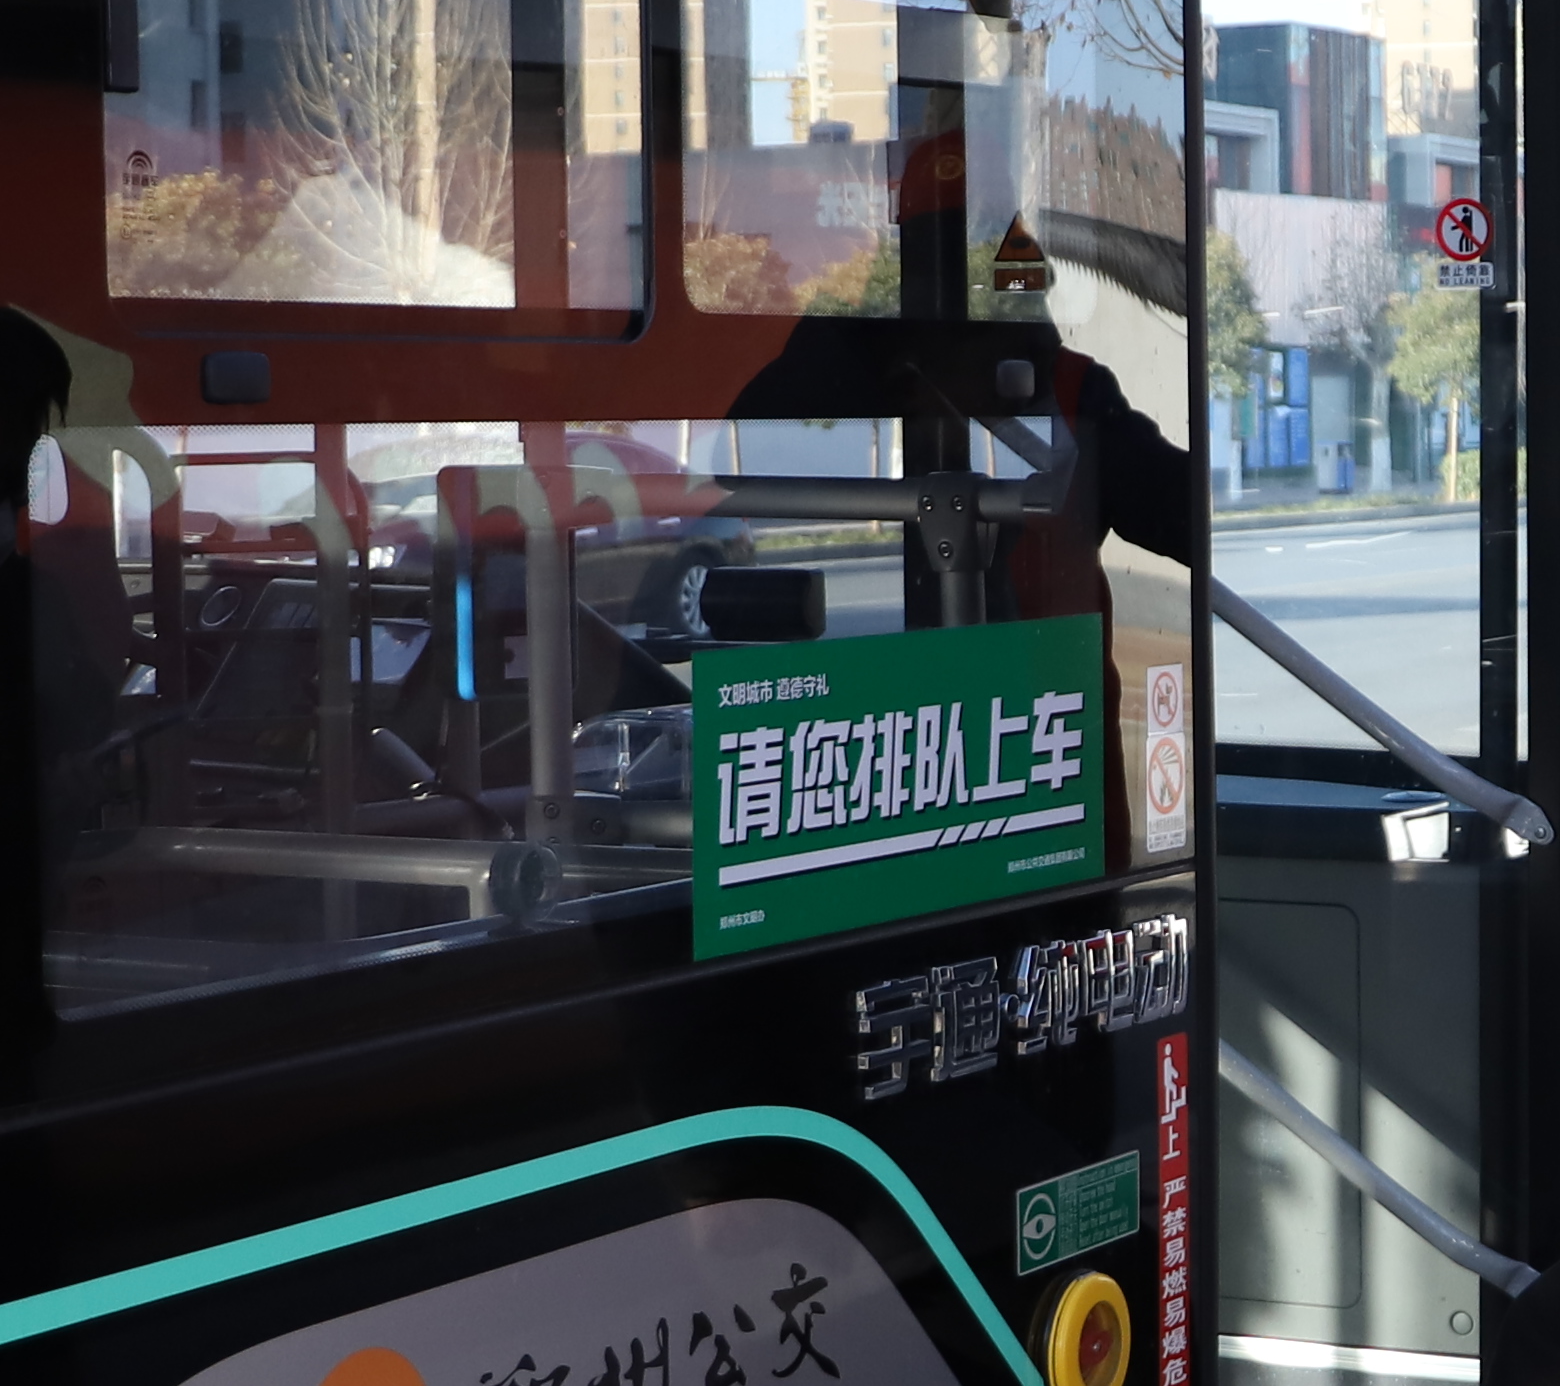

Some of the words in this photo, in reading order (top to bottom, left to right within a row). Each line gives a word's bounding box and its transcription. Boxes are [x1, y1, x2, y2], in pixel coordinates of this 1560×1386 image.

[718, 679, 773, 708] 文明城市
[776, 673, 830, 701] 遵德守礼
[717, 691, 1085, 845] 请您排队上车
[1161, 1125, 1182, 1160] 上
